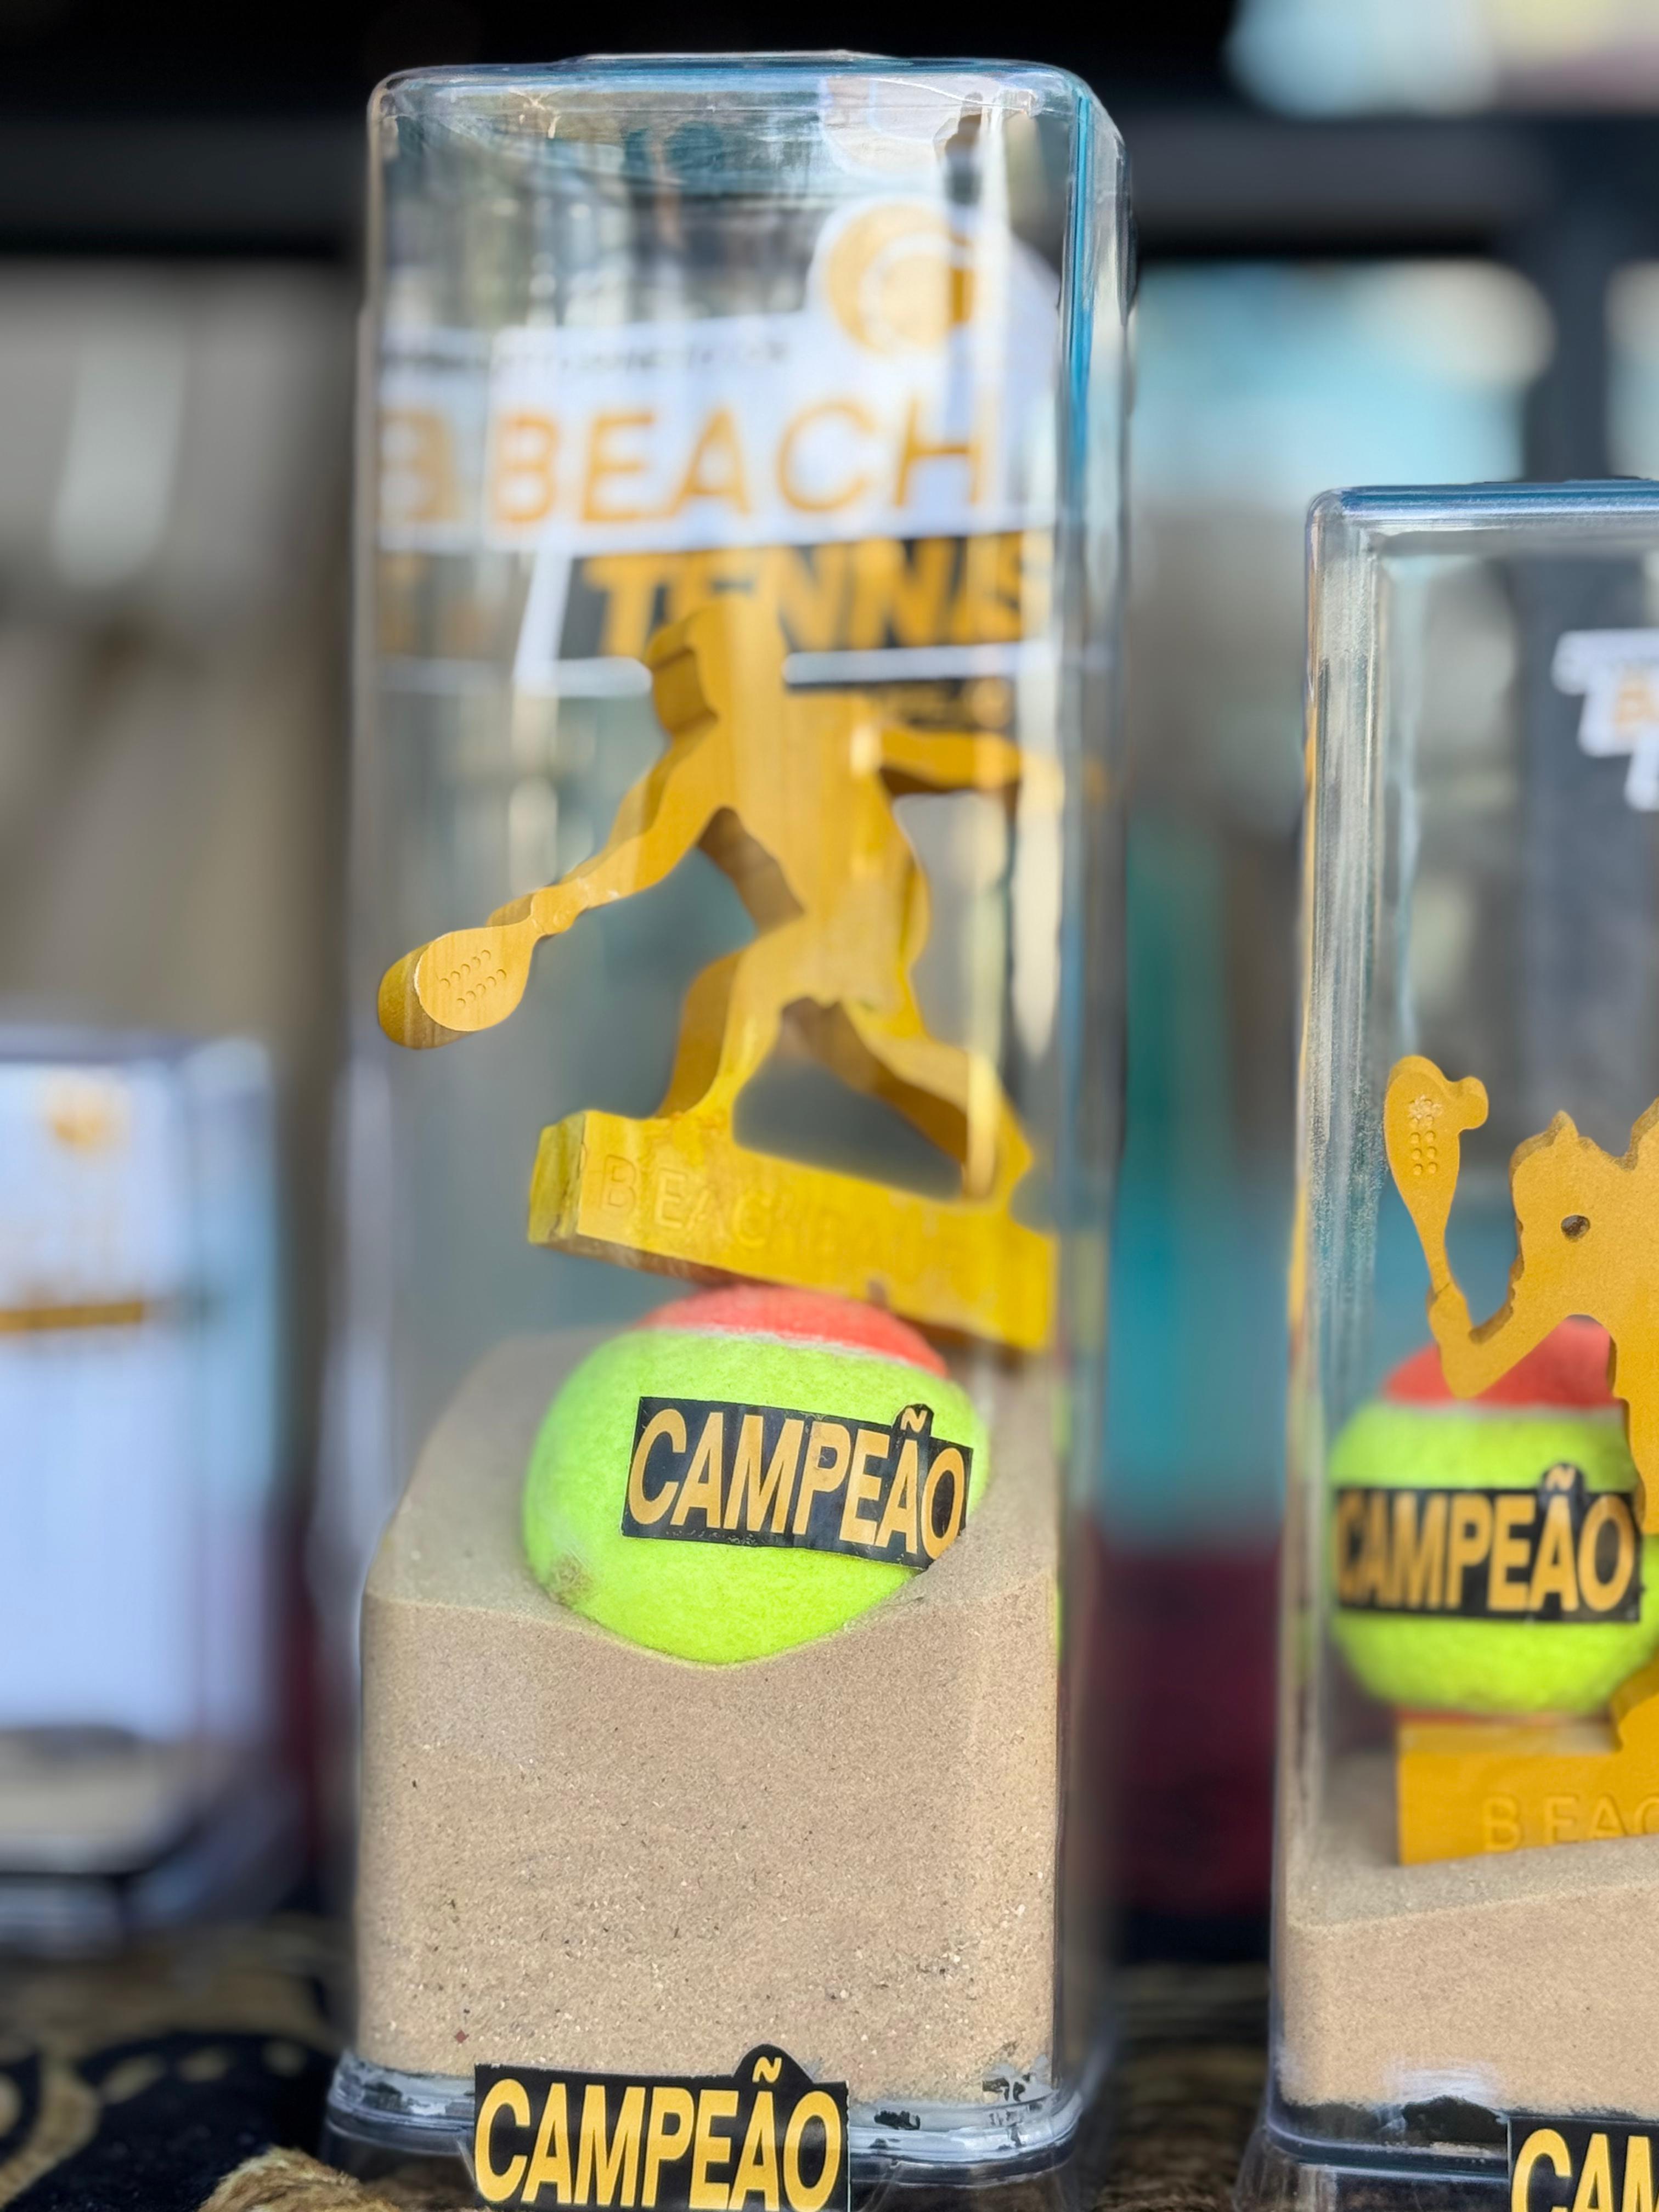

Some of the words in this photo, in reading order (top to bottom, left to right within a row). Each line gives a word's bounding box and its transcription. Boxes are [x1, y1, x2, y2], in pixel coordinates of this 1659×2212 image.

[488, 392, 988, 524] BEACH
[628, 1407, 966, 1560] CAMPEÃO
[1335, 1464, 1635, 1612] CAMPEÃO
[474, 2056, 841, 2212] CAMPEÃO
